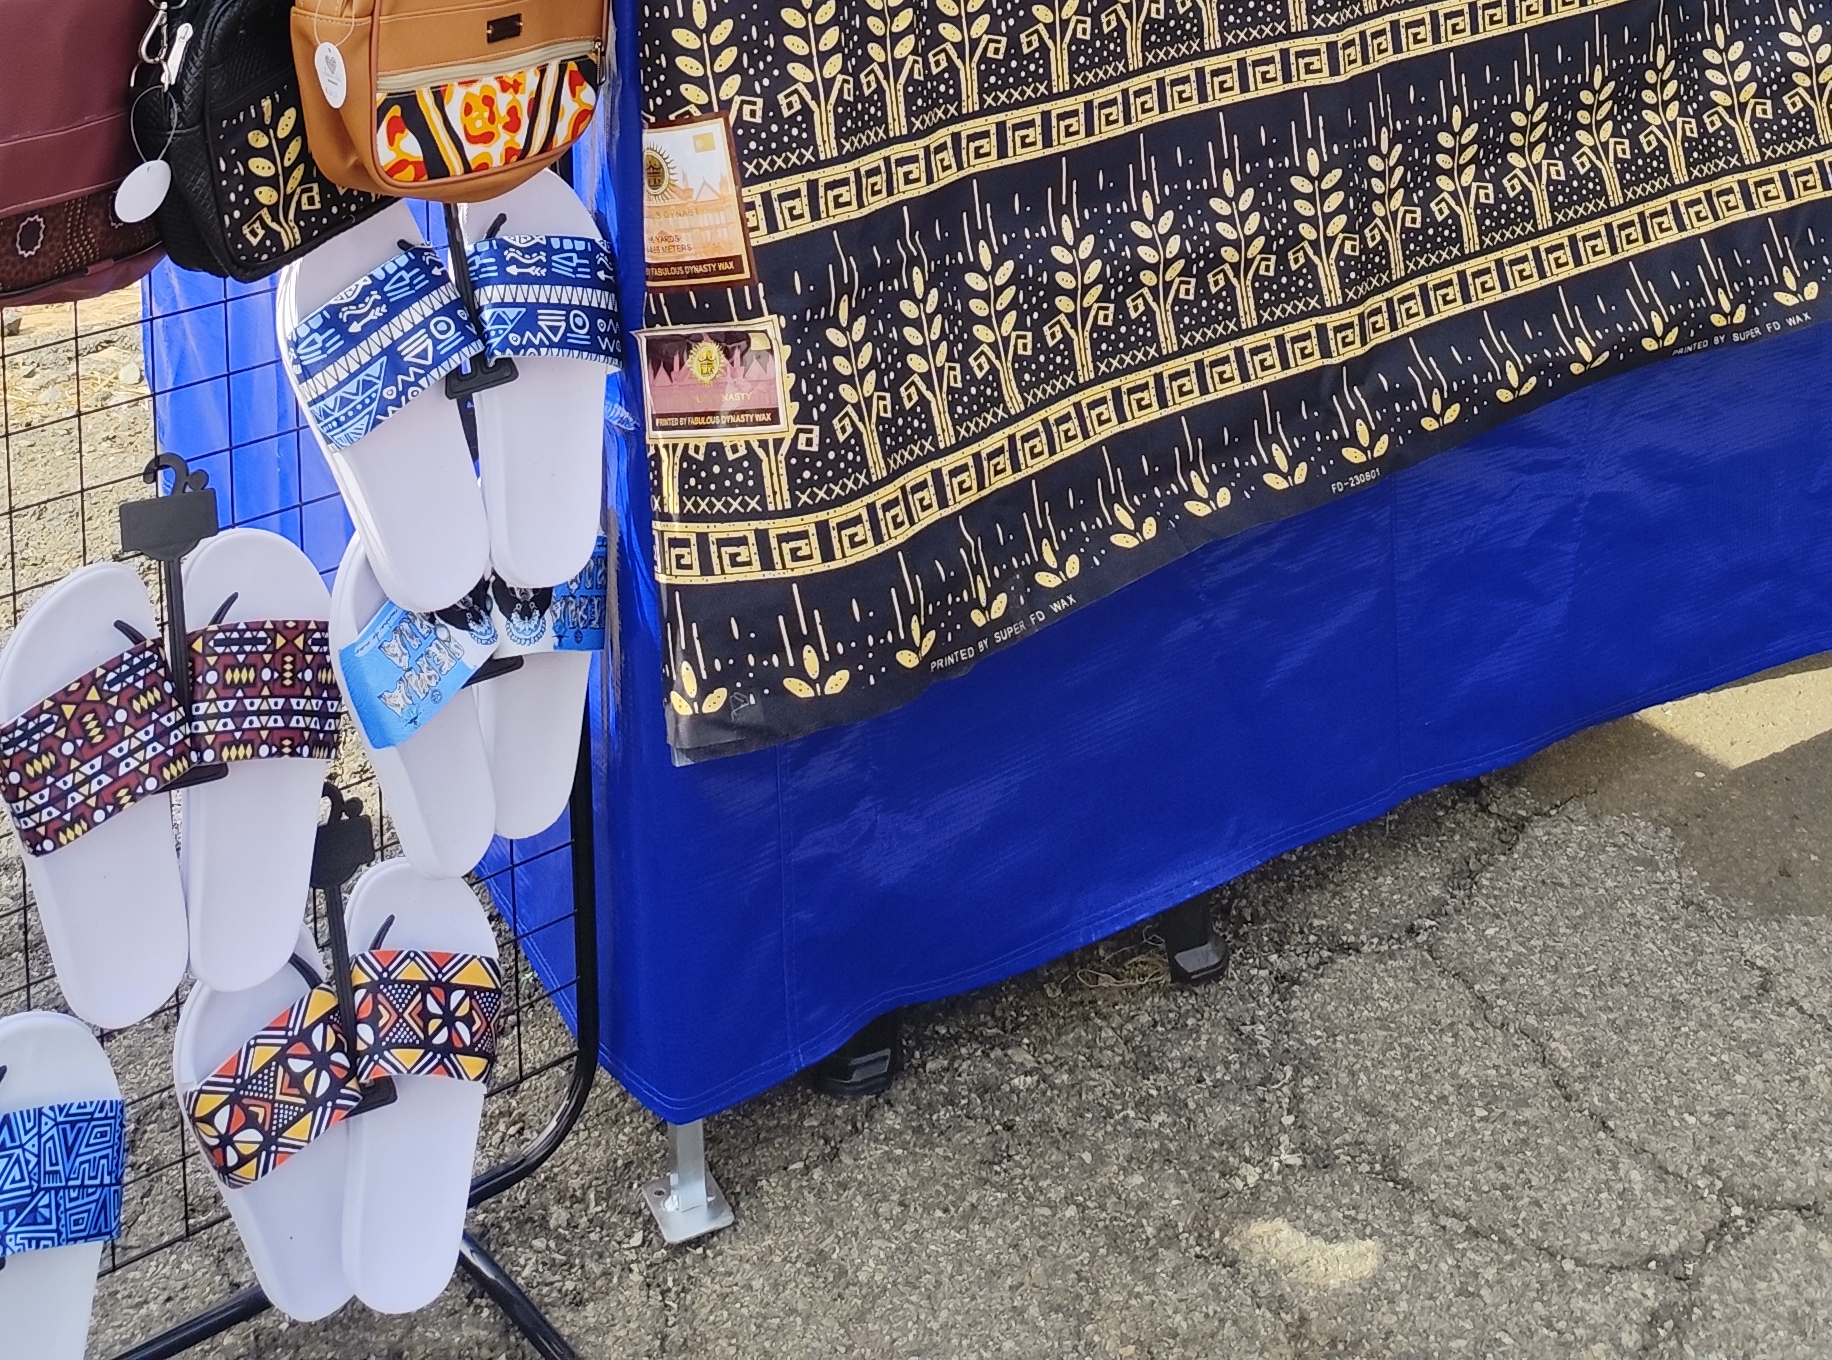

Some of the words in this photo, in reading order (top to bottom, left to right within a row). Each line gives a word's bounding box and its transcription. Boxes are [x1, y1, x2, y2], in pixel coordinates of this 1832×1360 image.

[655, 234, 680, 243] YARDS
[661, 243, 693, 254] METERS
[651, 265, 685, 277] FABULOUS
[684, 261, 717, 275] DYNASTY
[717, 260, 735, 271] WAX
[655, 417, 679, 427] PRINTED
[679, 416, 688, 426] BY
[688, 415, 721, 426] FABULOUS
[721, 413, 754, 424] DYNASTY
[754, 412, 772, 422] WAX
[930, 646, 975, 673] PRINTED
[977, 637, 989, 653] BY
[993, 620, 1027, 644] SUPER
[1029, 610, 1046, 626] FD
[1049, 593, 1078, 614] WAX
